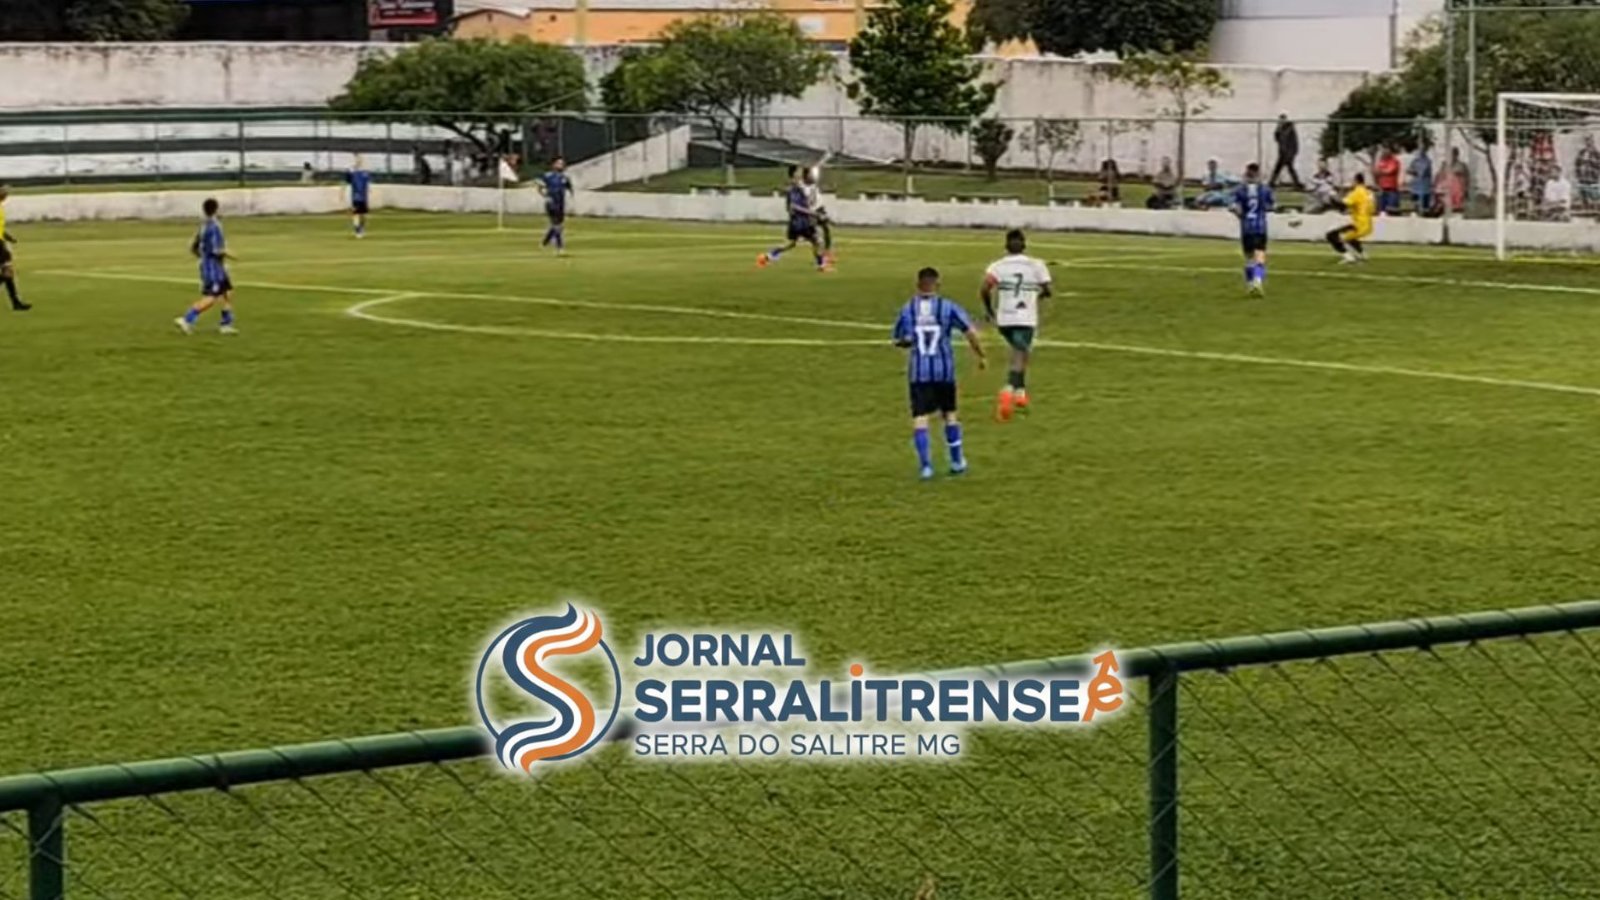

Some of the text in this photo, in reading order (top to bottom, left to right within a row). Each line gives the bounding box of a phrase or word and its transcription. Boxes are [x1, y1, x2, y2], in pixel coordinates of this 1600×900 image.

[1246, 199, 1258, 218] 2
[1013, 273, 1023, 298] 7
[915, 325, 940, 355] 17
